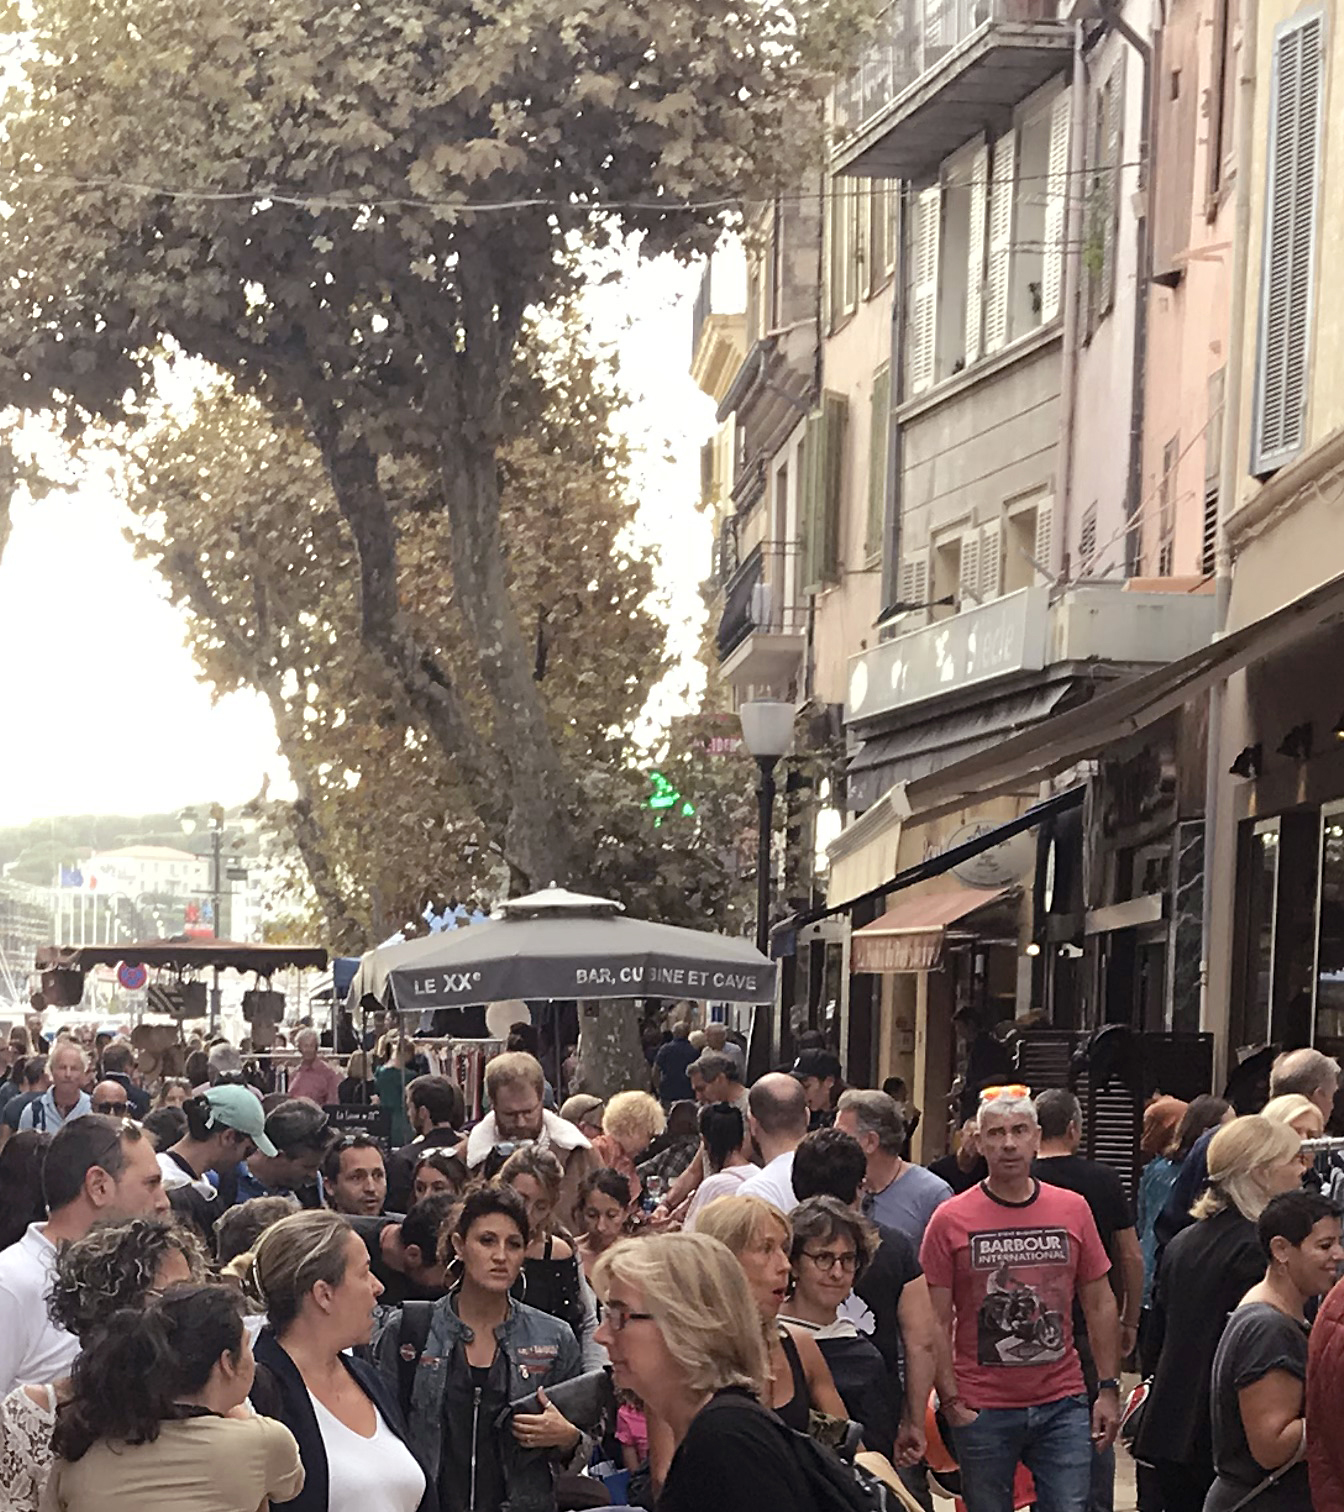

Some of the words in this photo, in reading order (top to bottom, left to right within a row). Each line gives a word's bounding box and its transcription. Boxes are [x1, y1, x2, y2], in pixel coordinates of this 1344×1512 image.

[414, 977, 436, 995] LE
[576, 968, 616, 986] BAR,
[620, 966, 684, 984] CUSINE
[688, 971, 709, 986] ET
[713, 972, 757, 990] CAVE
[980, 1236, 1062, 1254] BARBOUR
[978, 1251, 1066, 1264] INTERNATIONAL
